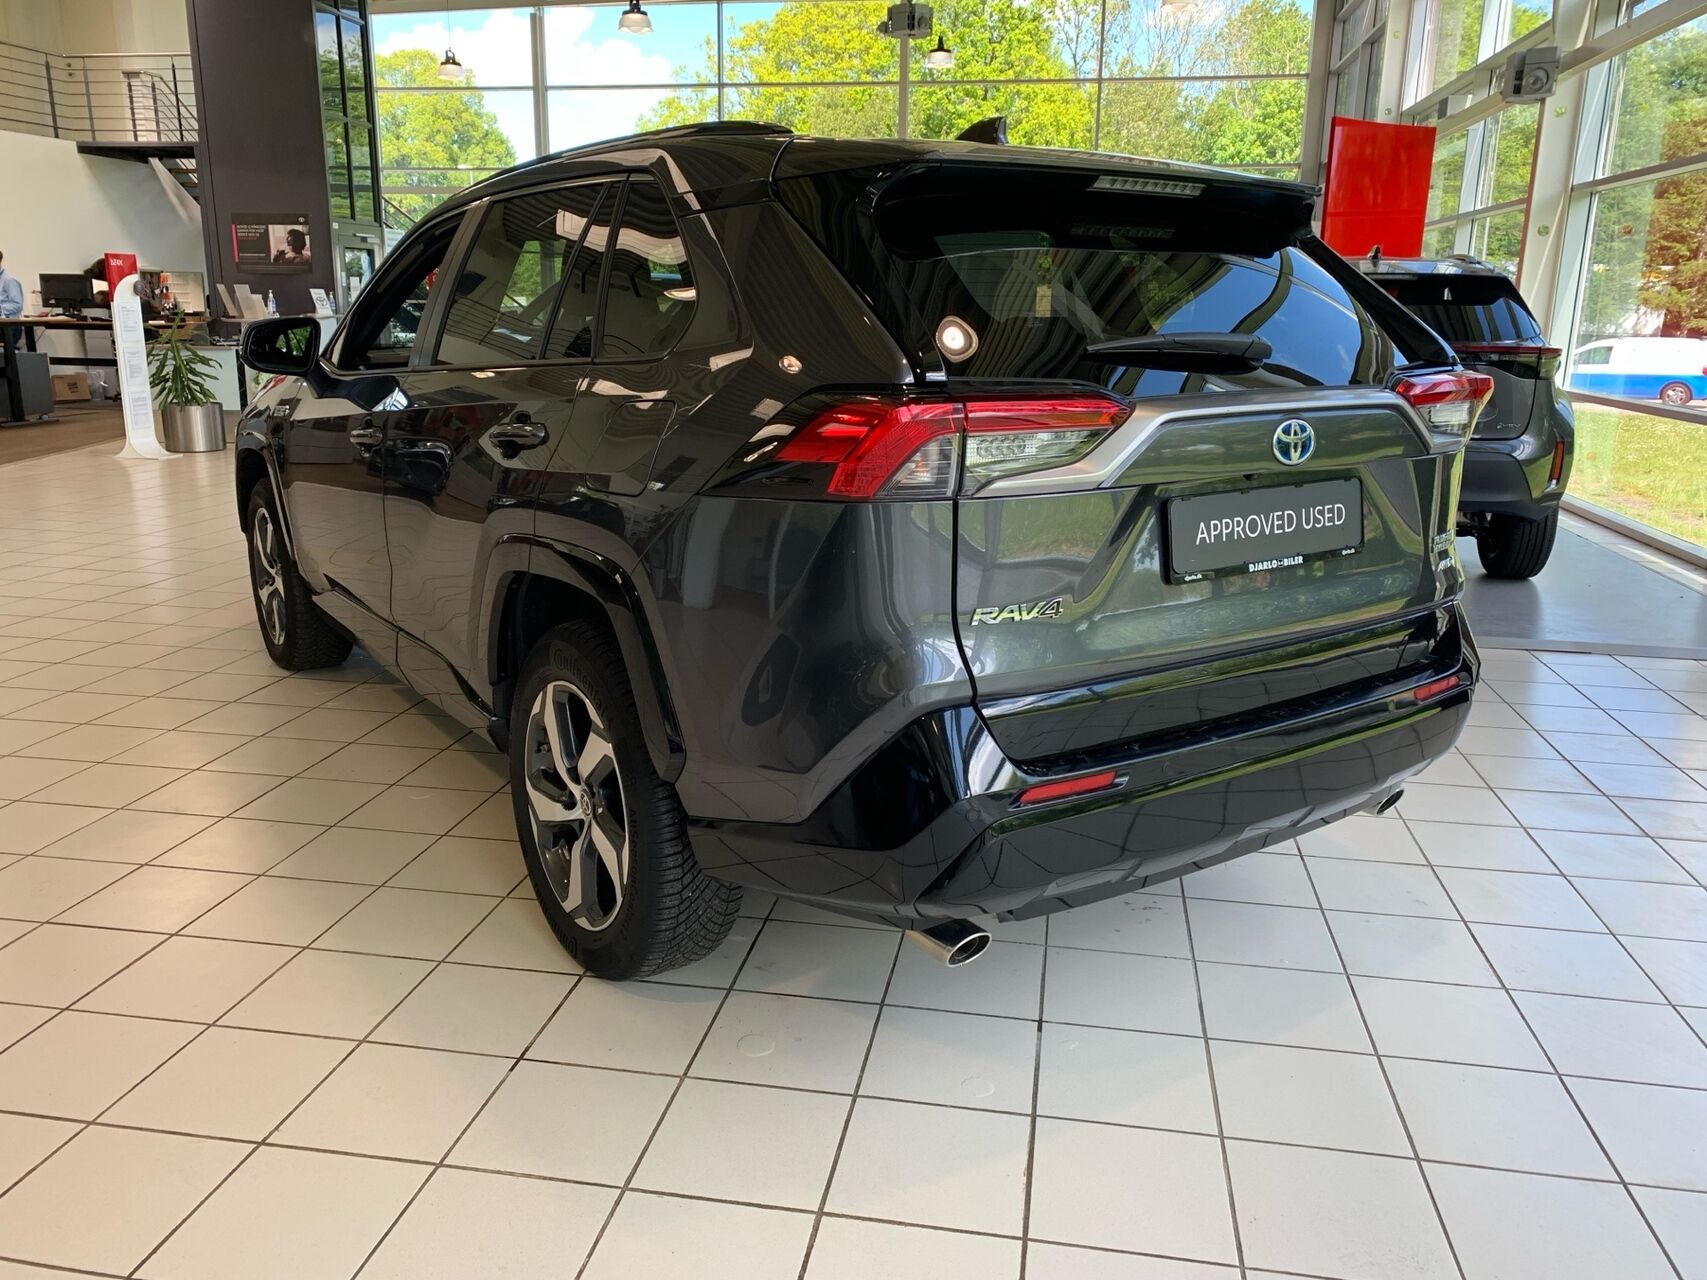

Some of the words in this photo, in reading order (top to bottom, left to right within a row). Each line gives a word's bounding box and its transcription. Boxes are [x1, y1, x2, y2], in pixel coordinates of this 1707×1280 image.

[1195, 510, 1297, 545] APPROVED
[1302, 503, 1346, 530] USED
[1249, 559, 1278, 572] DJARLO
[1284, 555, 1304, 567] BILER
[970, 598, 1064, 626] RAV4
